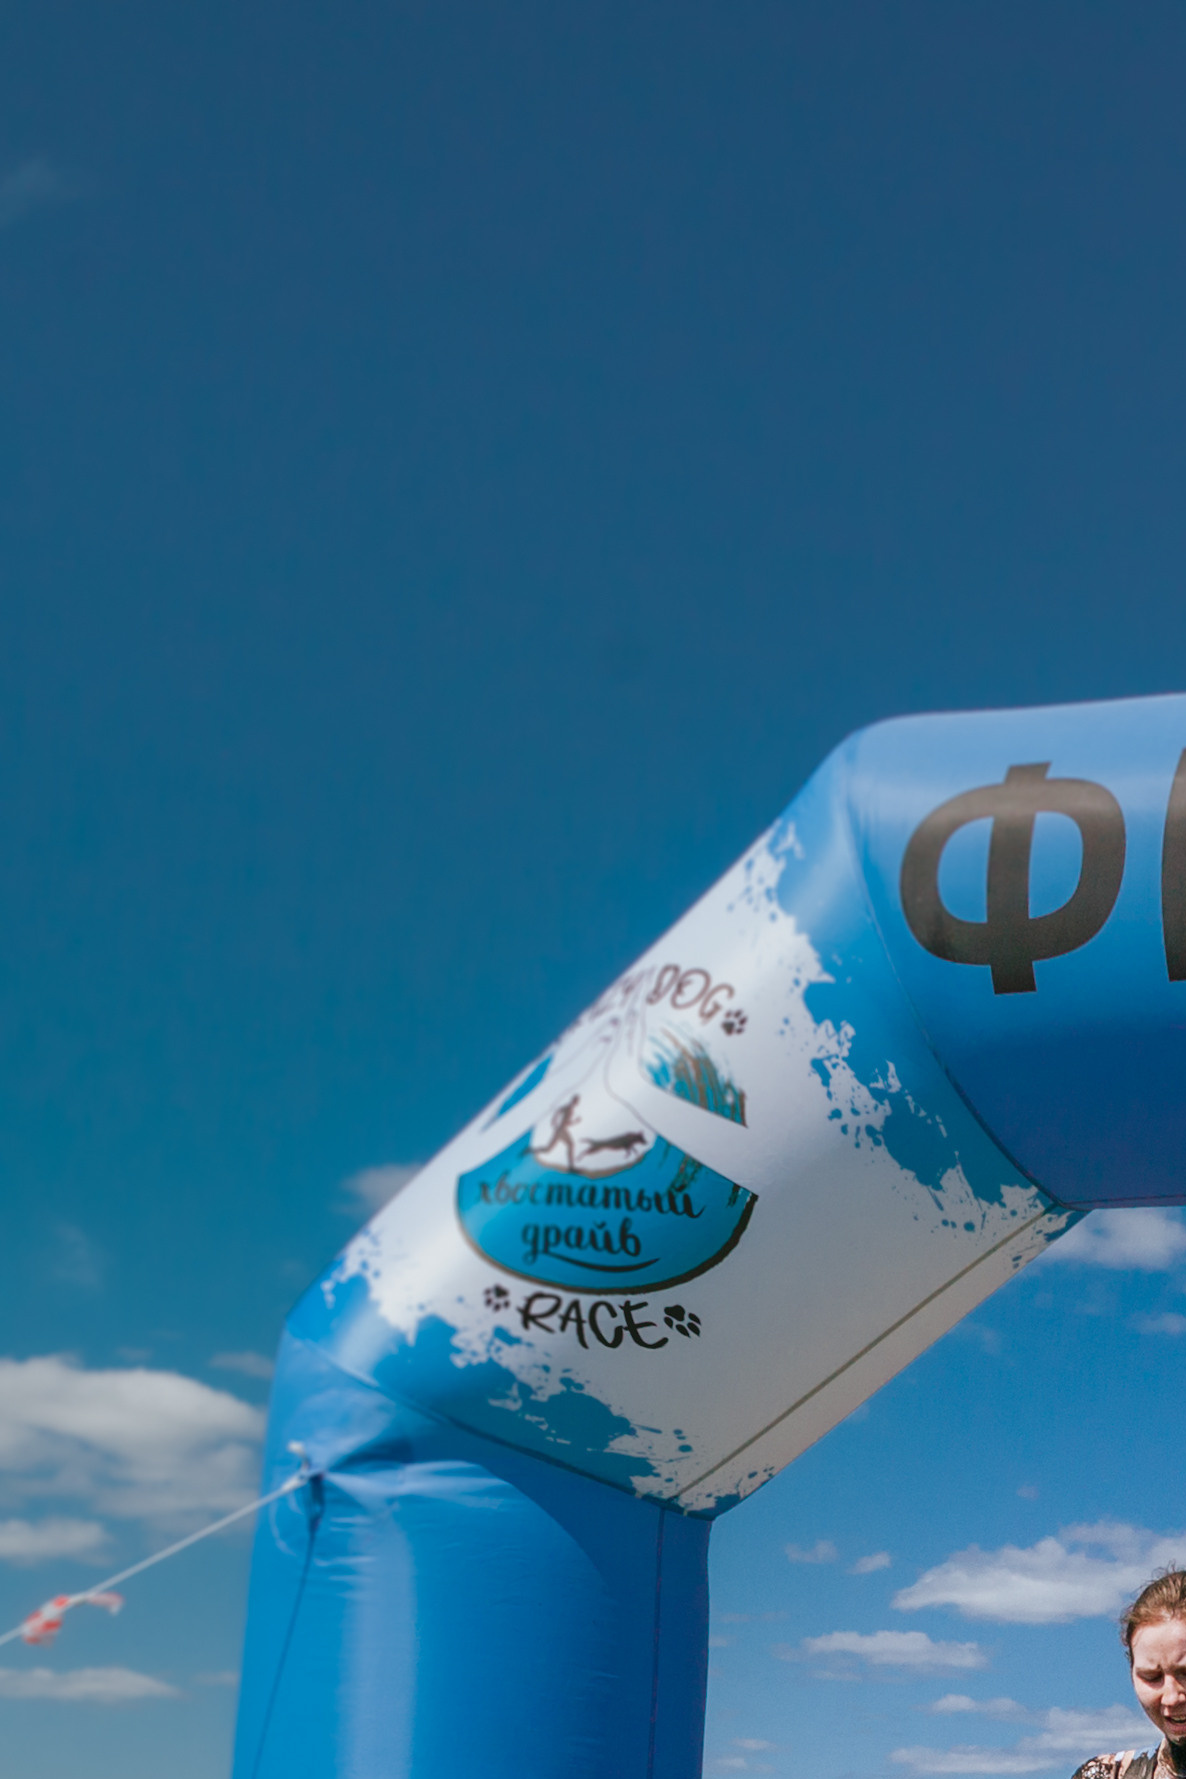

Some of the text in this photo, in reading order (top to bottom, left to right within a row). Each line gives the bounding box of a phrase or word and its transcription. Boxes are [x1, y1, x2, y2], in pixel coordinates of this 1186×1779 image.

[646, 963, 735, 1026] DOG
[521, 1216, 646, 1267] драйв
[516, 1292, 668, 1349] RACE
